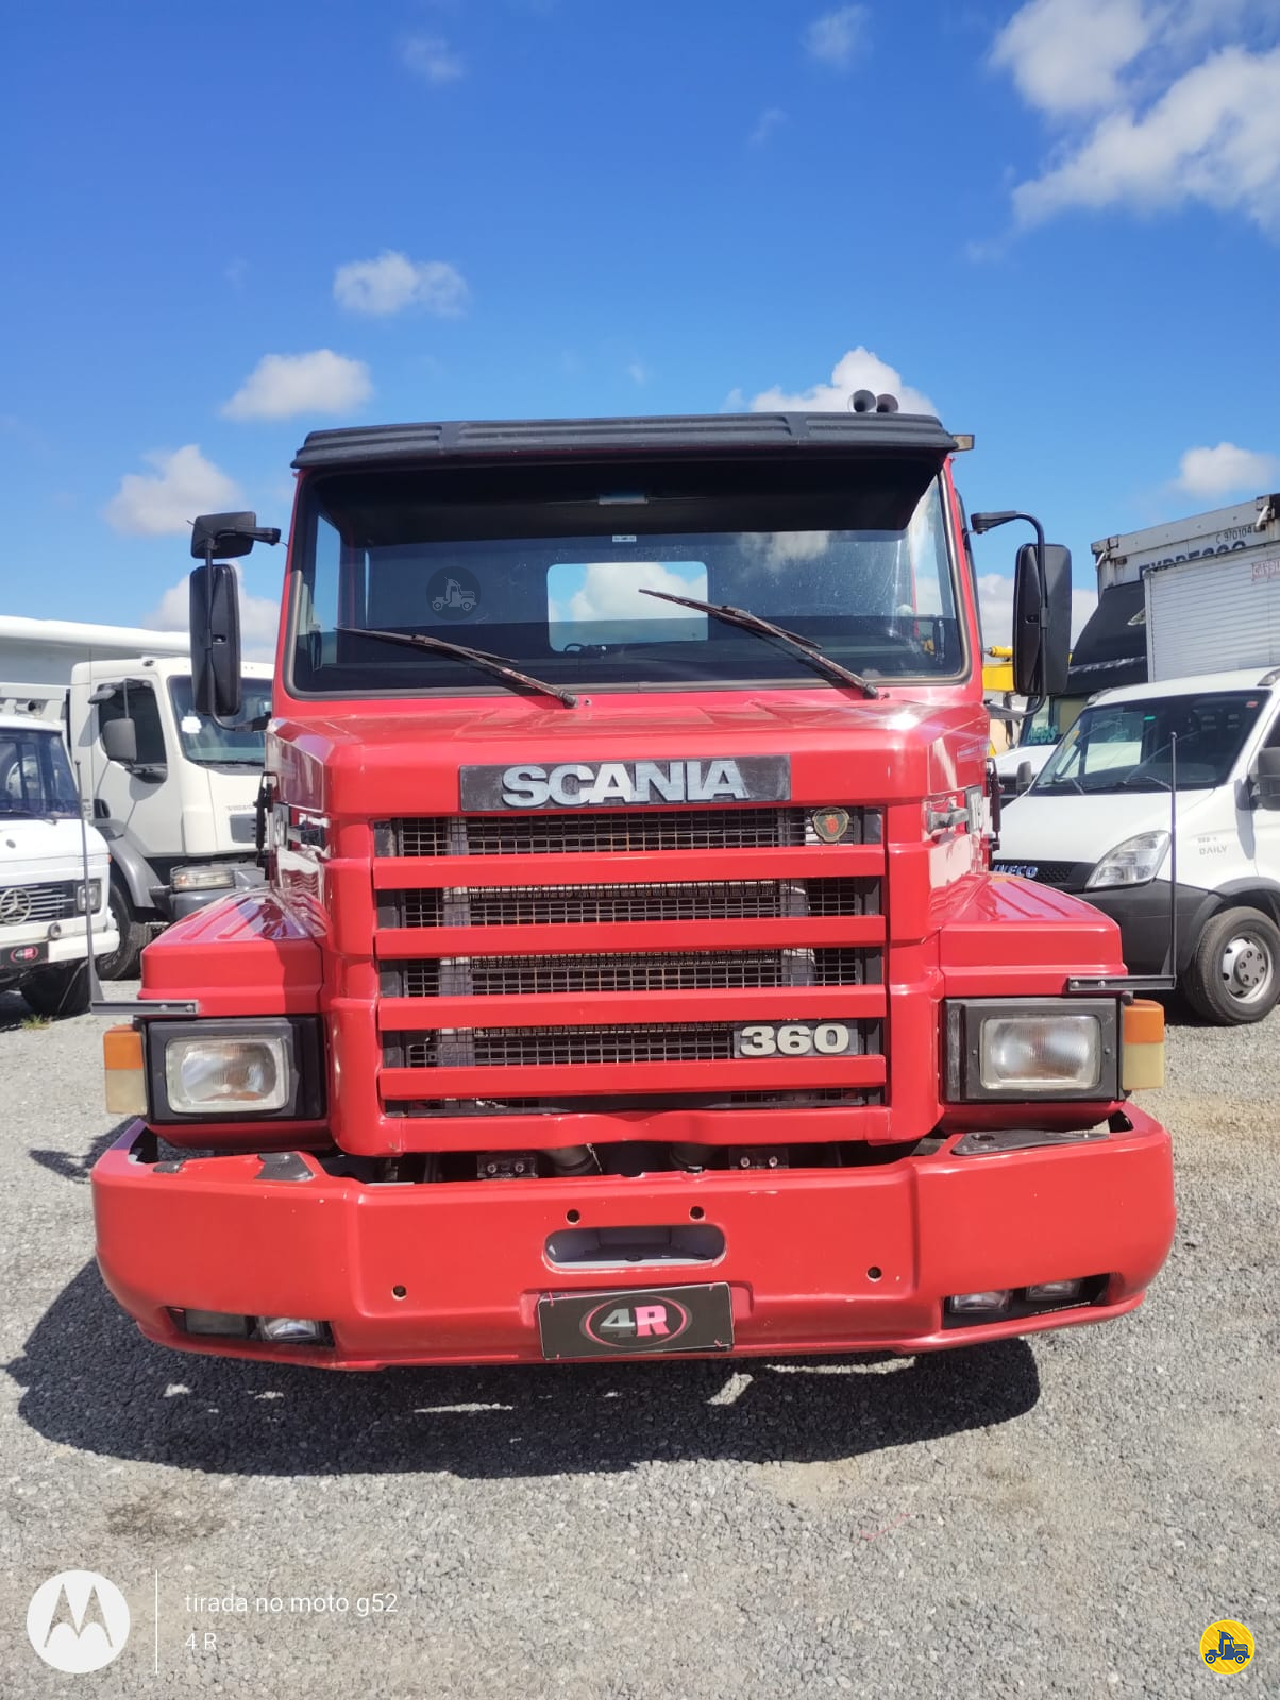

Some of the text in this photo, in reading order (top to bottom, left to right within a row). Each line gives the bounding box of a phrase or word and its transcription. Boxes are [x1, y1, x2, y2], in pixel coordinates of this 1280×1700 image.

[502, 760, 749, 808] SCANIA
[740, 1023, 849, 1056] 360
[600, 1305, 671, 1338] 4R
